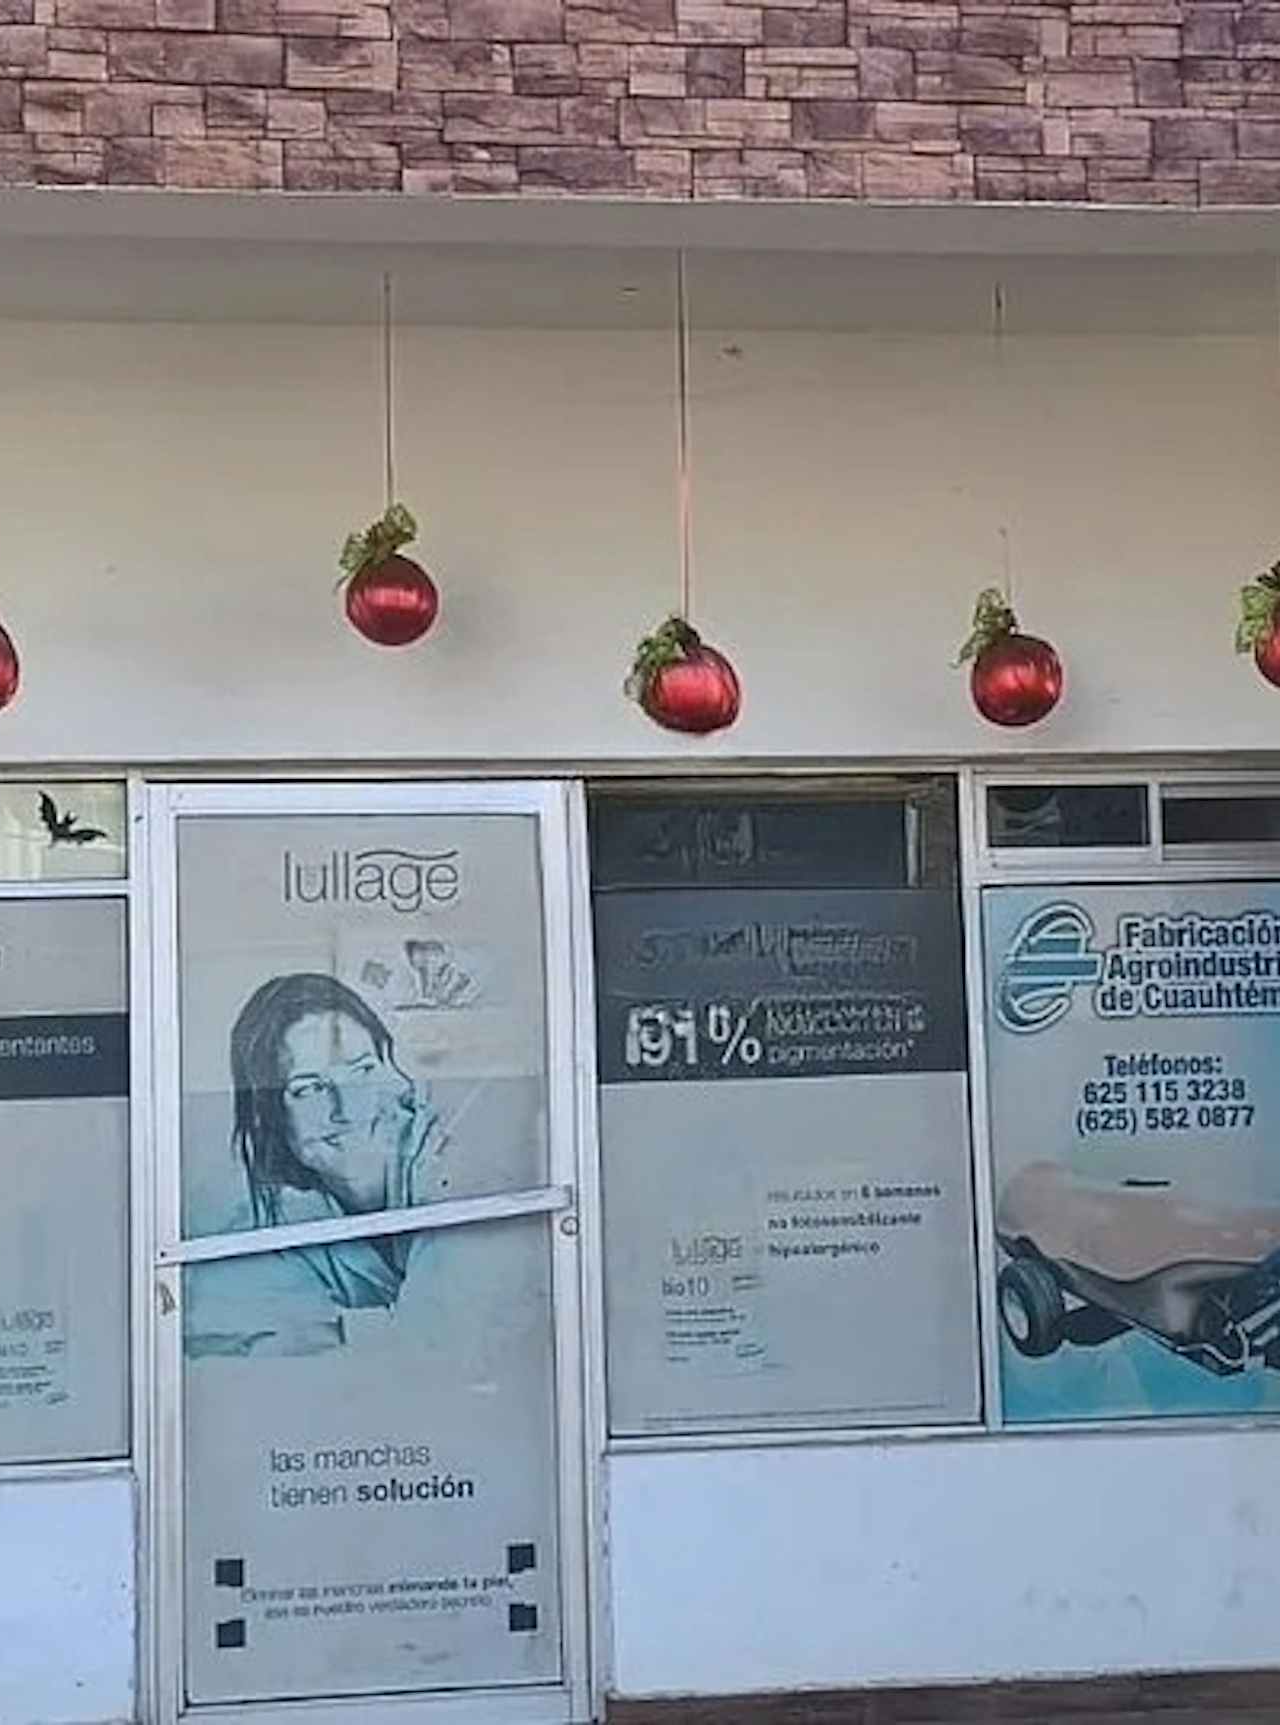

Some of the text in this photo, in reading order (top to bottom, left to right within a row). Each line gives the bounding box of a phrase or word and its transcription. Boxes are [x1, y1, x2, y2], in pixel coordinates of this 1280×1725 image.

[283, 849, 459, 913] lullage
[1099, 986, 1133, 1012] de
[1104, 1053, 1224, 1076] Teléfonos:
[1084, 1078, 1247, 1105] 625 115 3238
[1076, 1105, 1256, 1137] (625) 582 0877
[270, 1444, 431, 1474] las manchas
[270, 1473, 475, 1508] tienen solución
